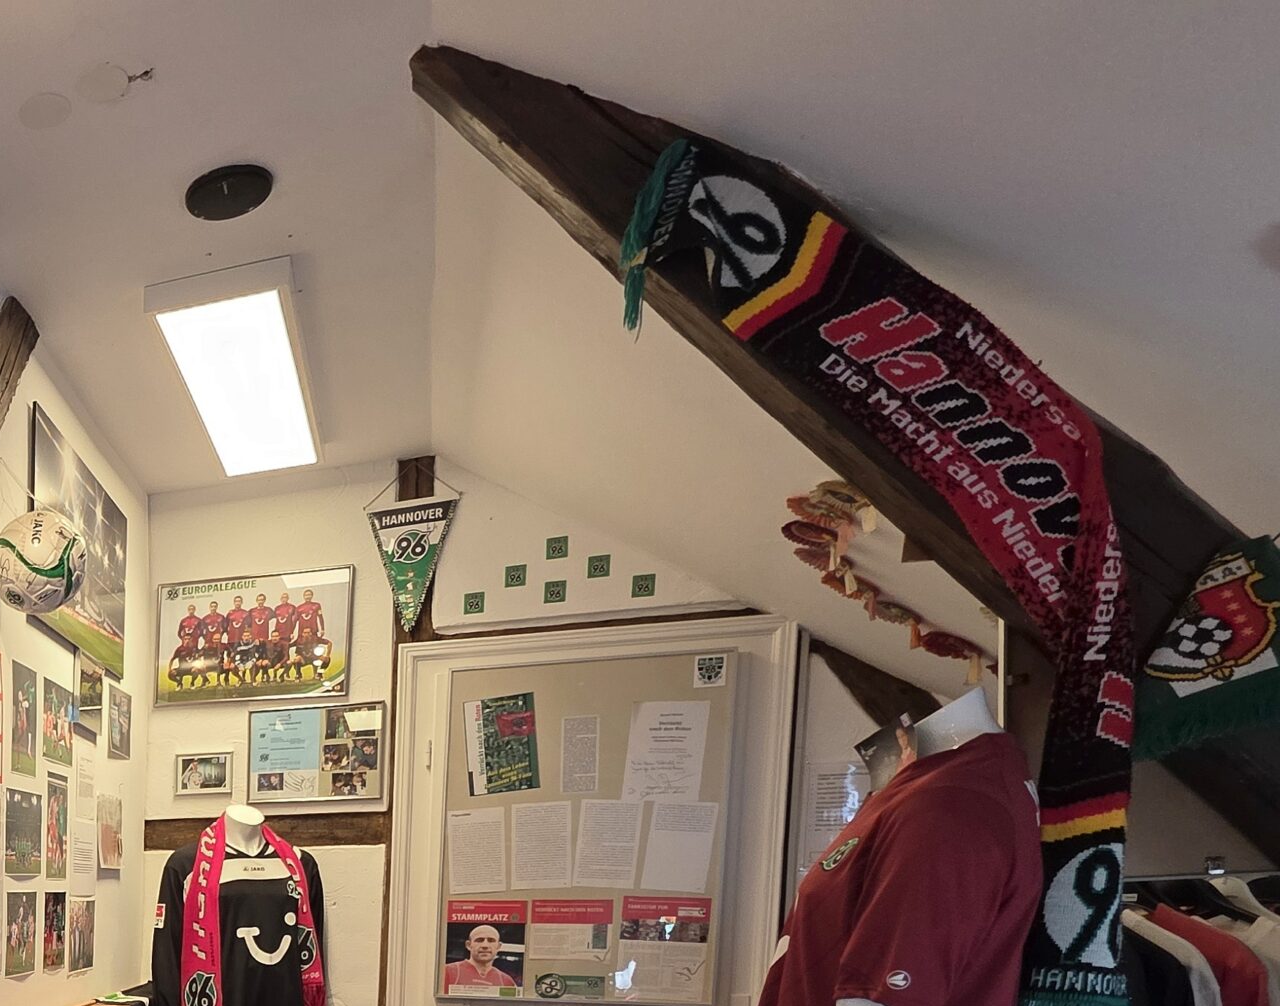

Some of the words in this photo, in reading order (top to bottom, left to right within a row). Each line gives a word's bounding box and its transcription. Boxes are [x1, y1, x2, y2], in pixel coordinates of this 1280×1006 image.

[820, 352, 868, 393] Die
[868, 386, 955, 467] Macht
[947, 460, 1001, 511] aus
[382, 507, 443, 528] HANNOVER
[393, 531, 430, 563] 96
[551, 544, 565, 556] 96
[592, 562, 606, 574] 96
[509, 572, 522, 584] 96
[181, 580, 258, 597] EUROPALEAGUE
[549, 588, 562, 600] 96
[637, 582, 651, 594] 96
[468, 600, 481, 612] 96
[474, 704, 482, 722] Roten
[451, 912, 509, 922] STAMMPLATZ
